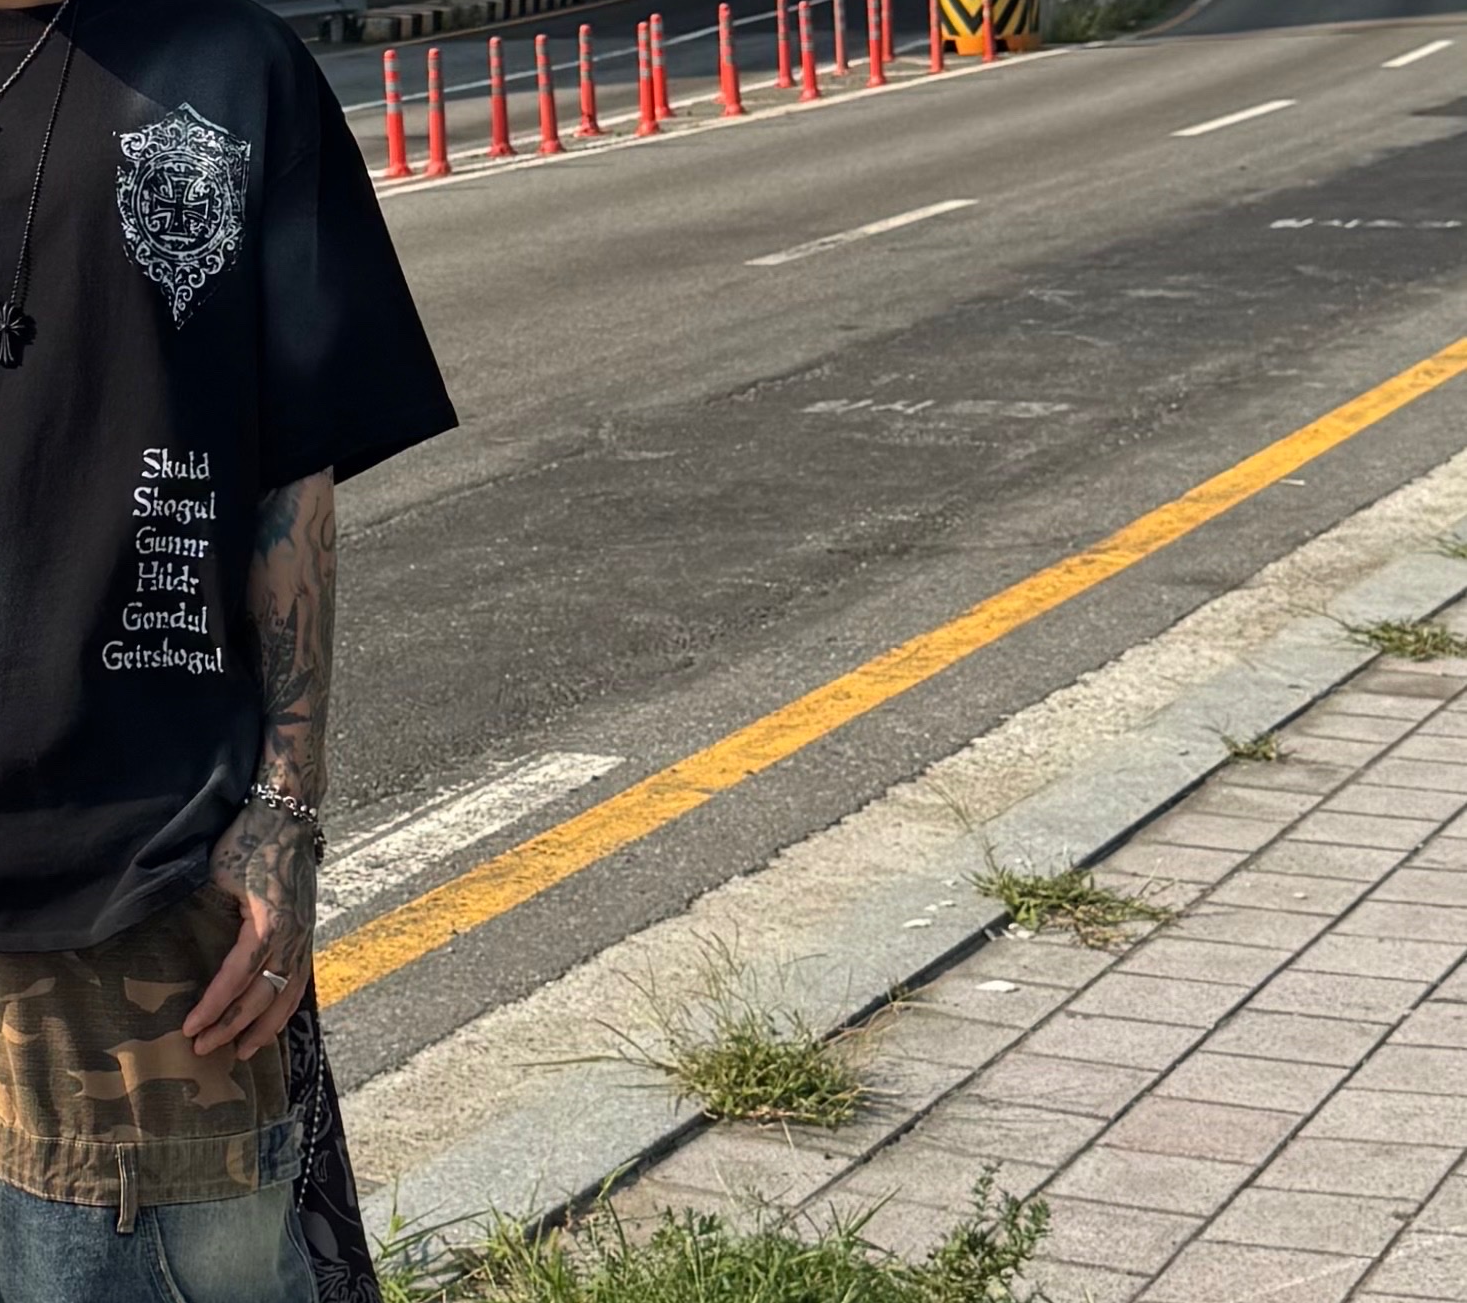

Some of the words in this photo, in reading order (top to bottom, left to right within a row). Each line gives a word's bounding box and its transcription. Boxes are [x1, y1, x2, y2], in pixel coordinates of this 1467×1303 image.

[141, 448, 211, 479] Skuld
[132, 487, 217, 524] Skogul
[136, 526, 209, 558] Gunnr
[123, 602, 208, 634] Gondul
[102, 637, 224, 675] Geirskogul
